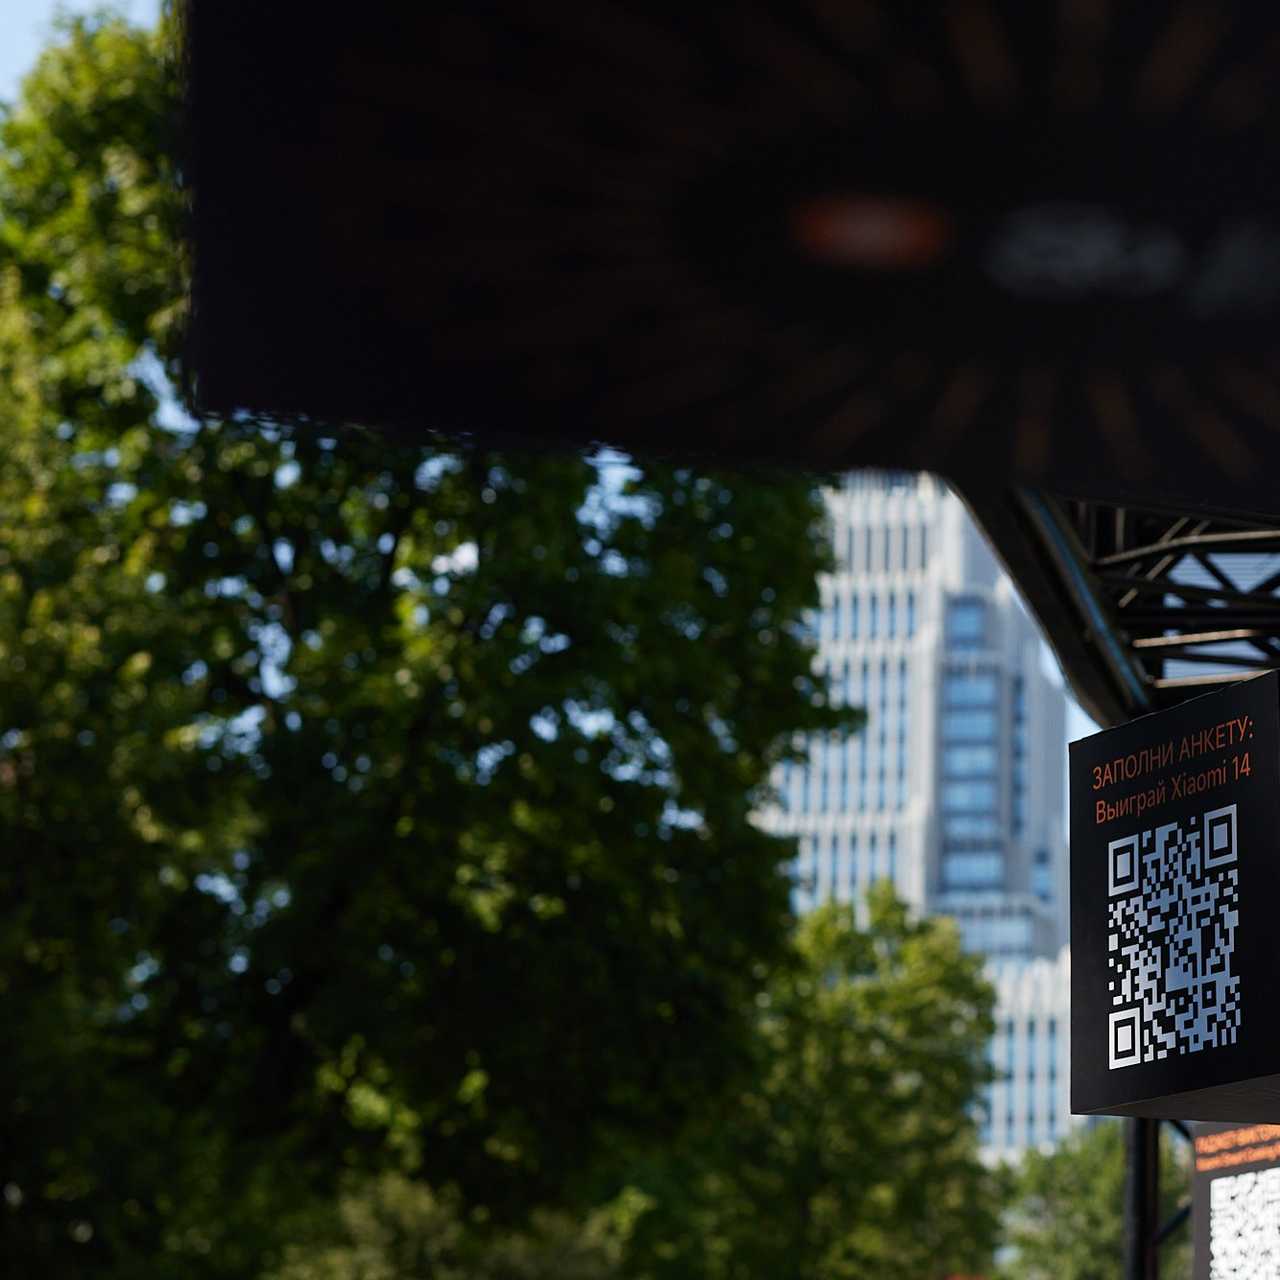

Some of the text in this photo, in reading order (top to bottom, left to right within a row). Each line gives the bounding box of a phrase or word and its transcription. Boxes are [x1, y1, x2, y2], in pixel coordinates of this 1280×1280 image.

[1092, 715, 1254, 790] ЗАПОЛНИ АНКЕТУ:
[1095, 752, 1251, 824] Выиграй Xiaomi 14
